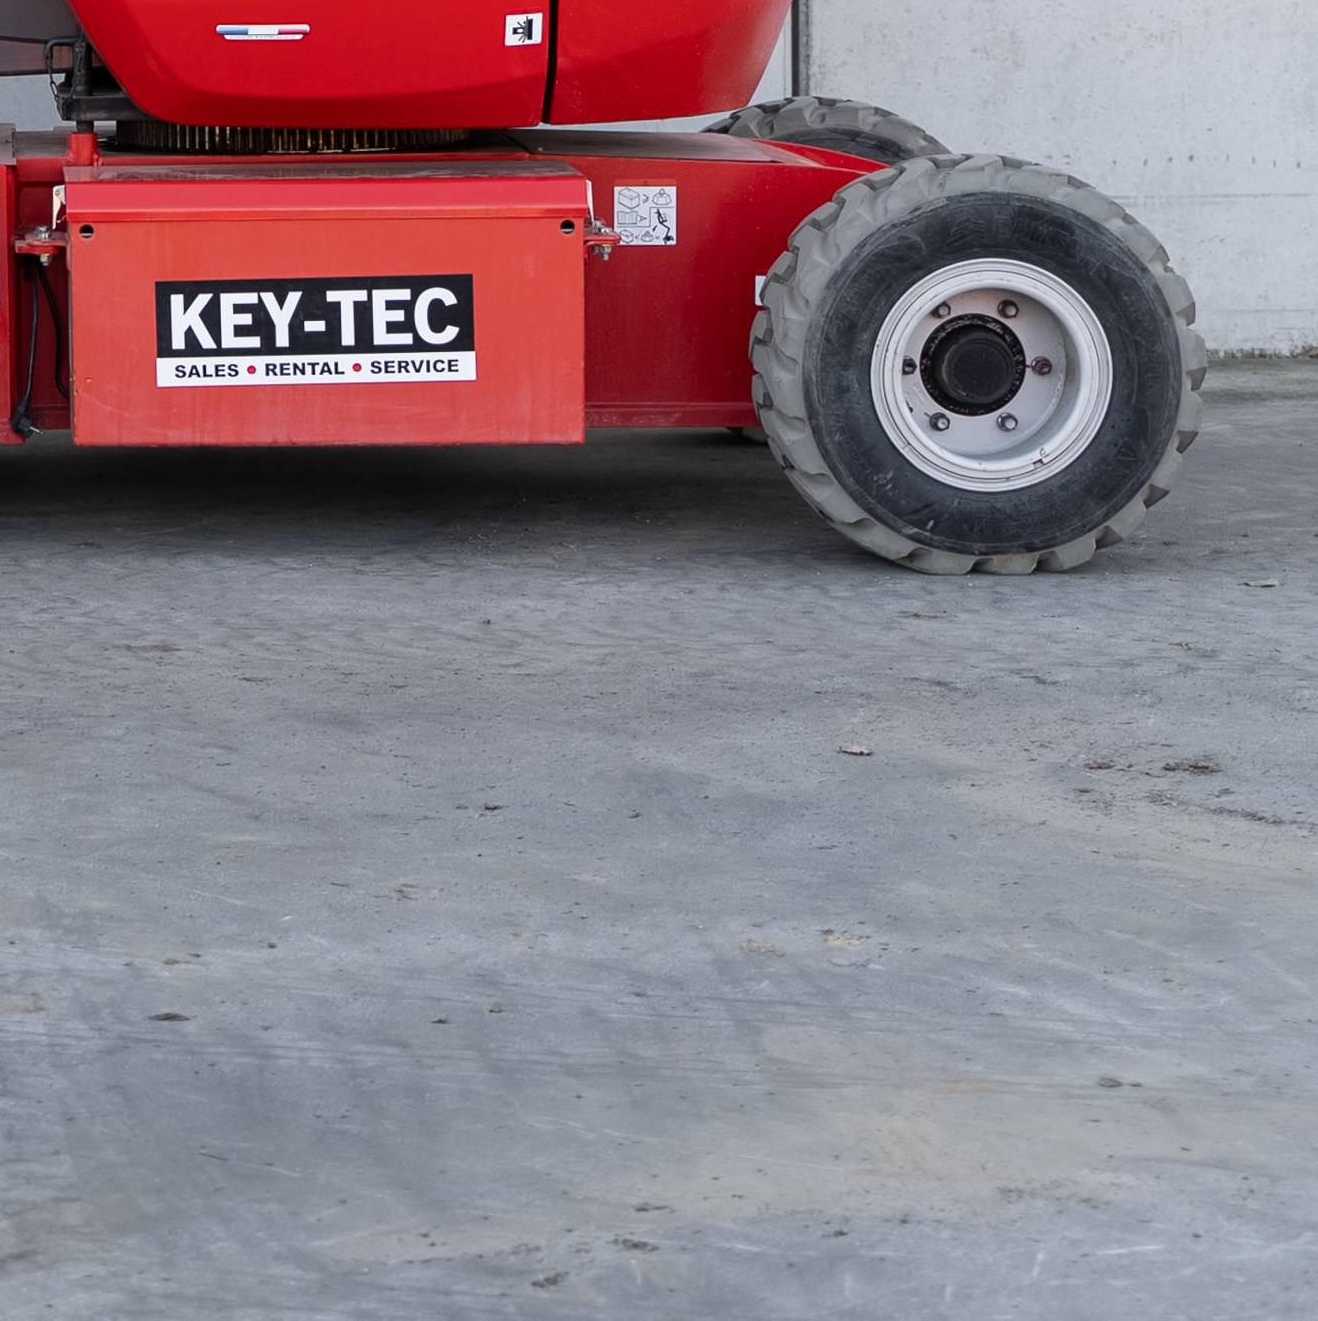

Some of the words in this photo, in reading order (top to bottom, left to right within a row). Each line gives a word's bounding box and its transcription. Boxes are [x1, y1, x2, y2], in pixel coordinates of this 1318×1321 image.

[170, 287, 460, 350] KEY-TEC
[174, 363, 240, 379] SALES
[264, 361, 346, 377] RENTAL
[370, 359, 459, 374] SERVICE
